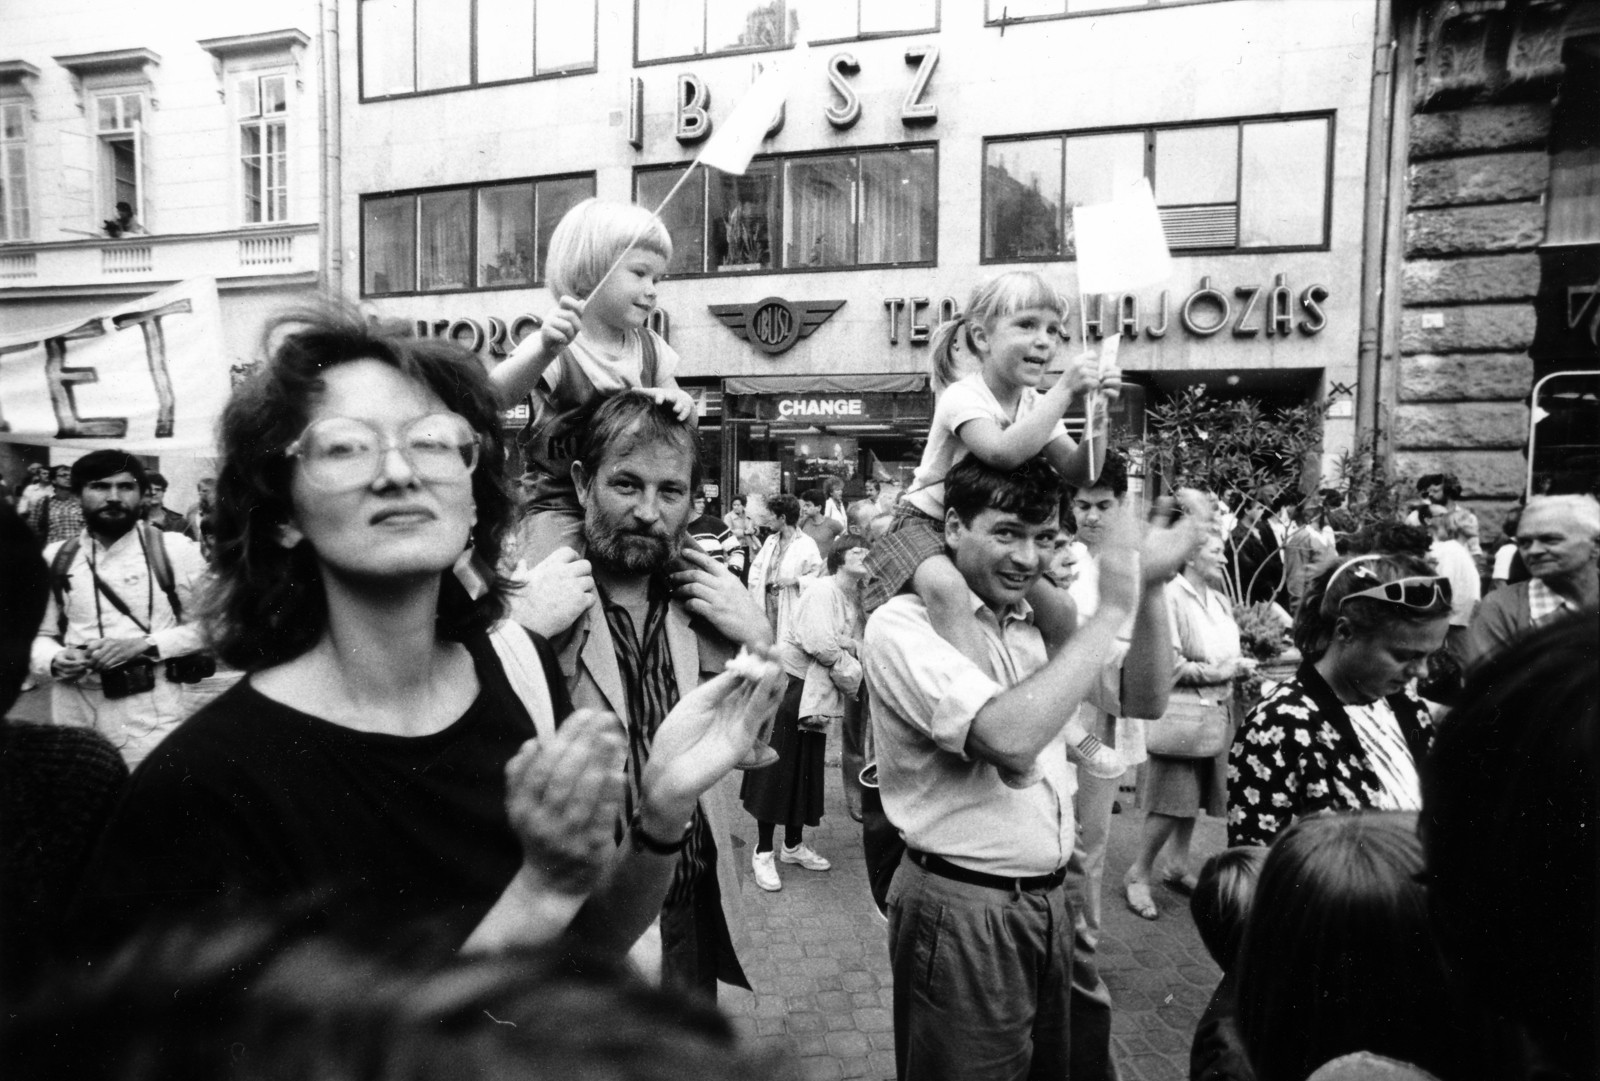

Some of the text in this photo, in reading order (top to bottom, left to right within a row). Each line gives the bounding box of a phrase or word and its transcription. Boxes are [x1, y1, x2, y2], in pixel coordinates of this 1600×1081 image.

[757, 307, 790, 345] IBUSZ
[0, 297, 193, 440] ET
[778, 399, 863, 416] CHANGE
